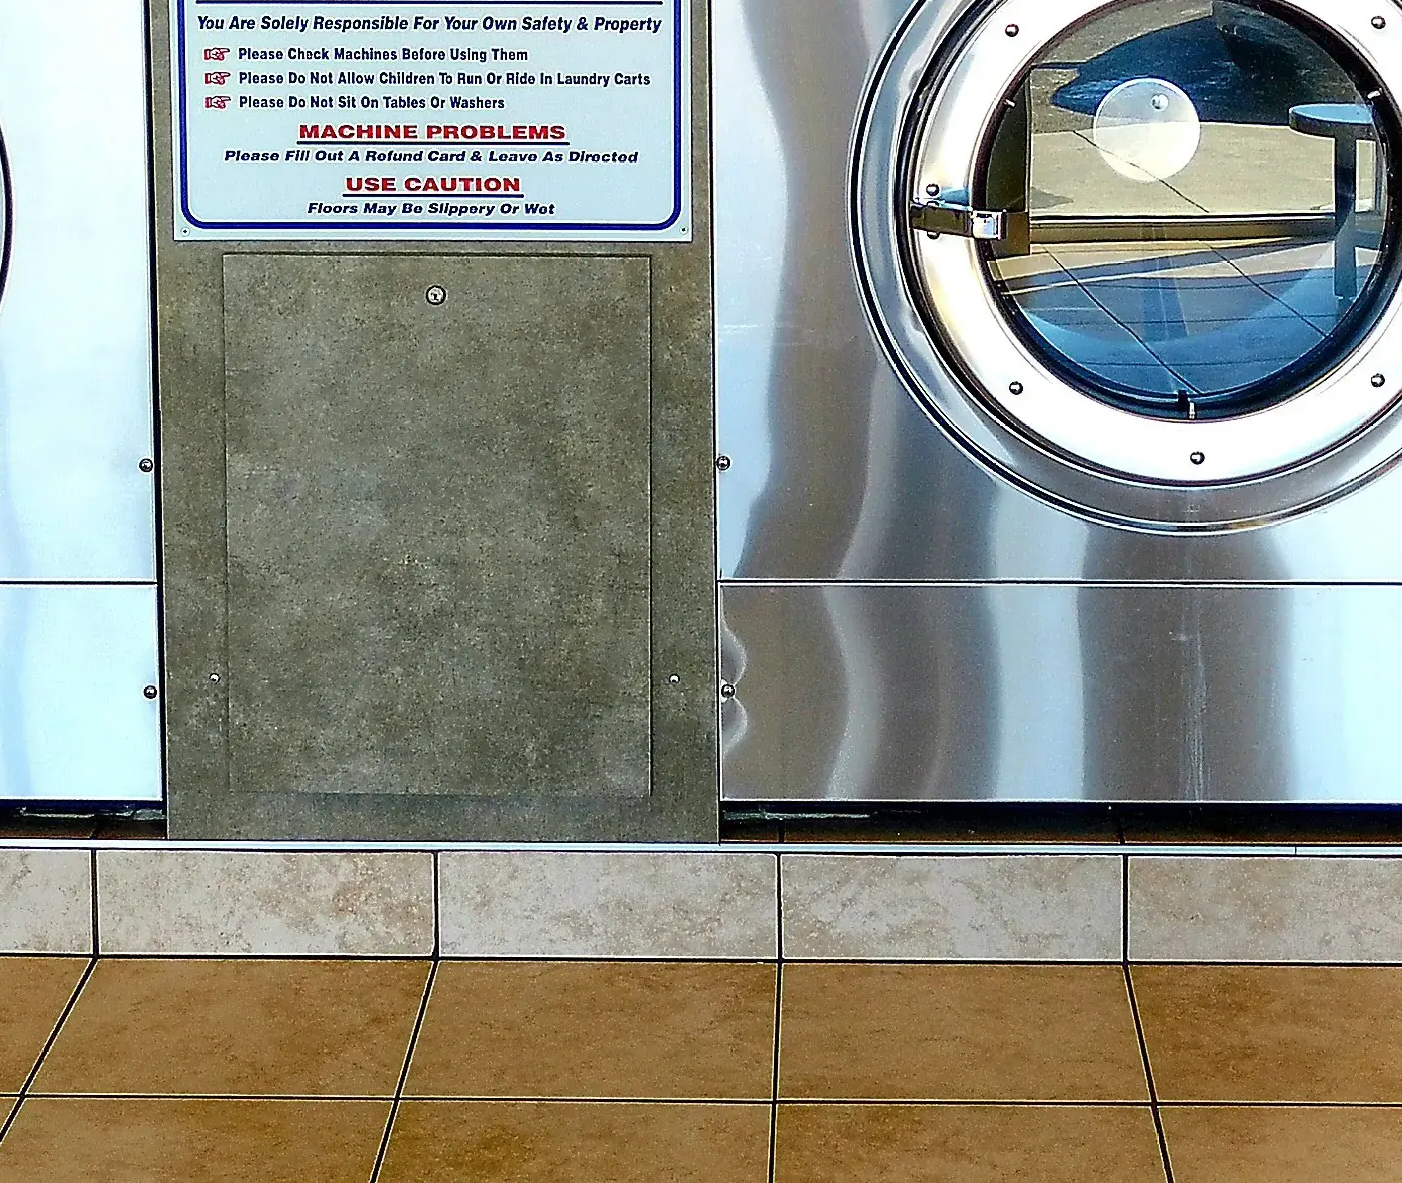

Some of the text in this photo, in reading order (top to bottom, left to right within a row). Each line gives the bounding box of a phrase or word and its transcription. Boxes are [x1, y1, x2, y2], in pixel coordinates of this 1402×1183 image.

[198, 16, 662, 33] You Are Solely Responsible For Your Own Safety & Property
[239, 48, 527, 62] Please Check Machines Before Using Them
[240, 72, 650, 87] Please Do Not Allow Children To Run Or Ride In Laundry Carts
[240, 96, 504, 108] Please Do Not Sit On Tables Or Washers
[300, 125, 565, 139] MACHINE PROBLEMS
[225, 150, 638, 163] Please Fill Out A Refund Card & Leave As Directed
[347, 178, 519, 191] USE CAUTION
[308, 203, 555, 216] Floors May Be Slippery Or Wet
